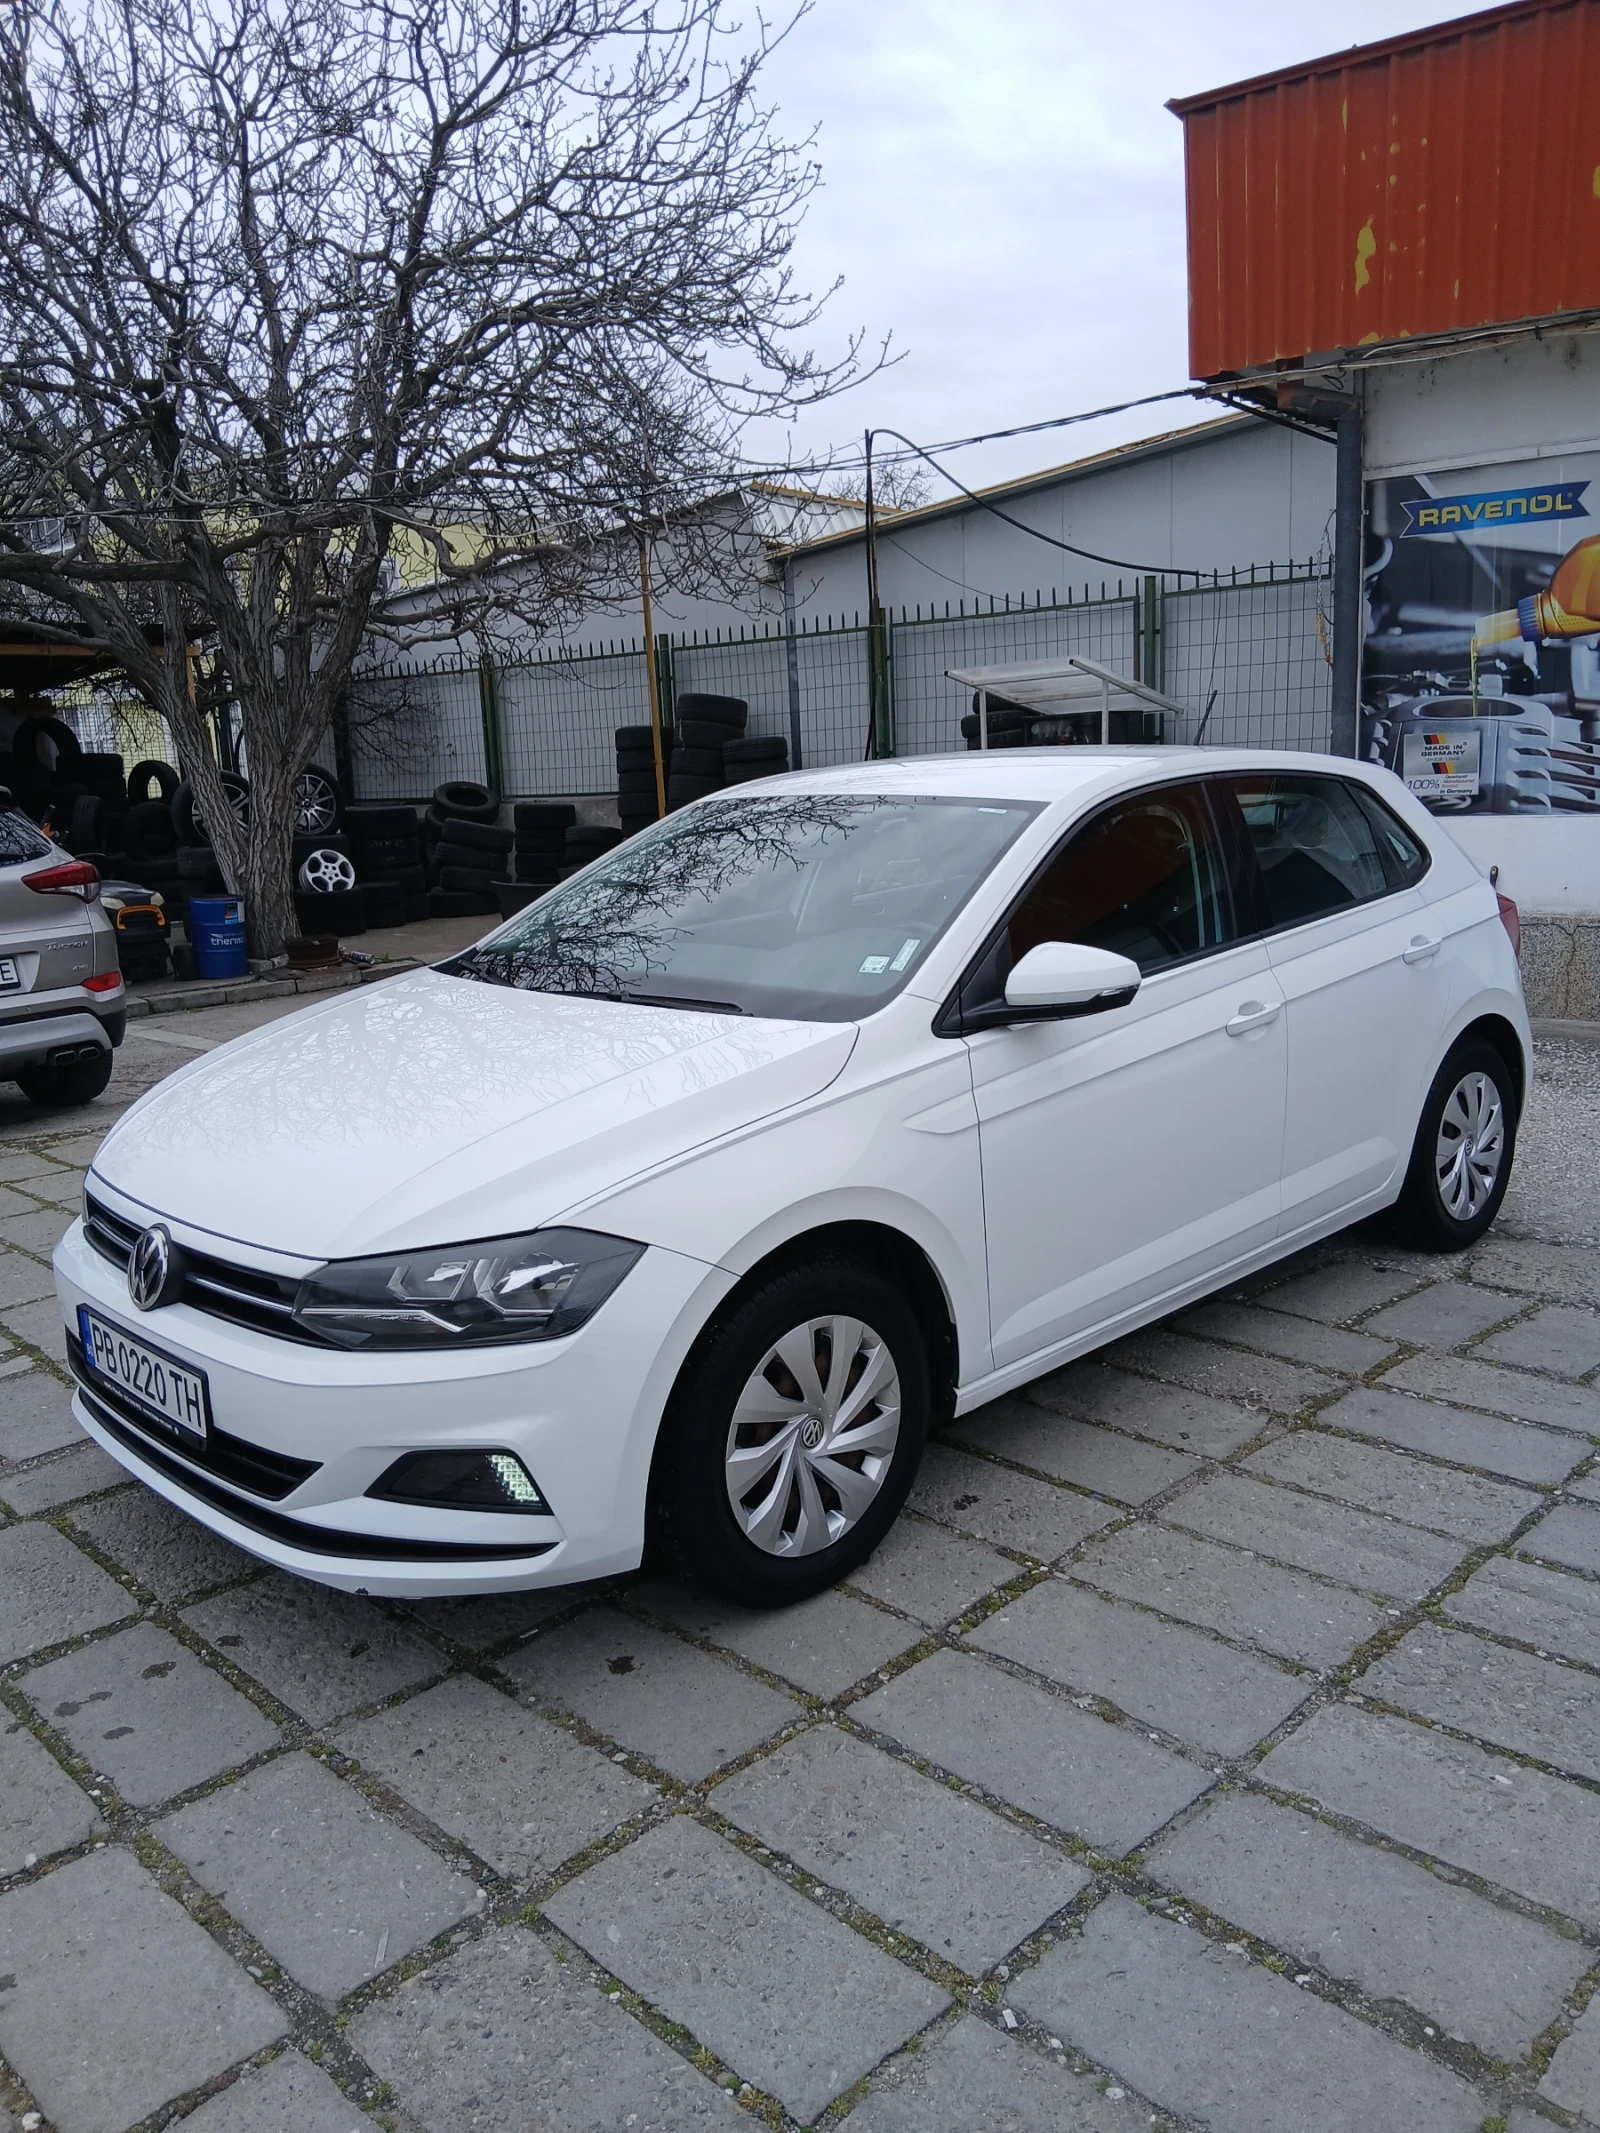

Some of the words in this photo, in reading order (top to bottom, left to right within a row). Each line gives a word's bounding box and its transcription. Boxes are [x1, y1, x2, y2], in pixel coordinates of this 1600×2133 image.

[1418, 492, 1573, 527] RAVENOL
[1421, 749, 1466, 757] GERMANY
[1407, 779, 1440, 790] 100%
[92, 1322, 117, 1375] PB
[118, 1341, 167, 1407] 0220
[168, 1368, 202, 1429] TH
